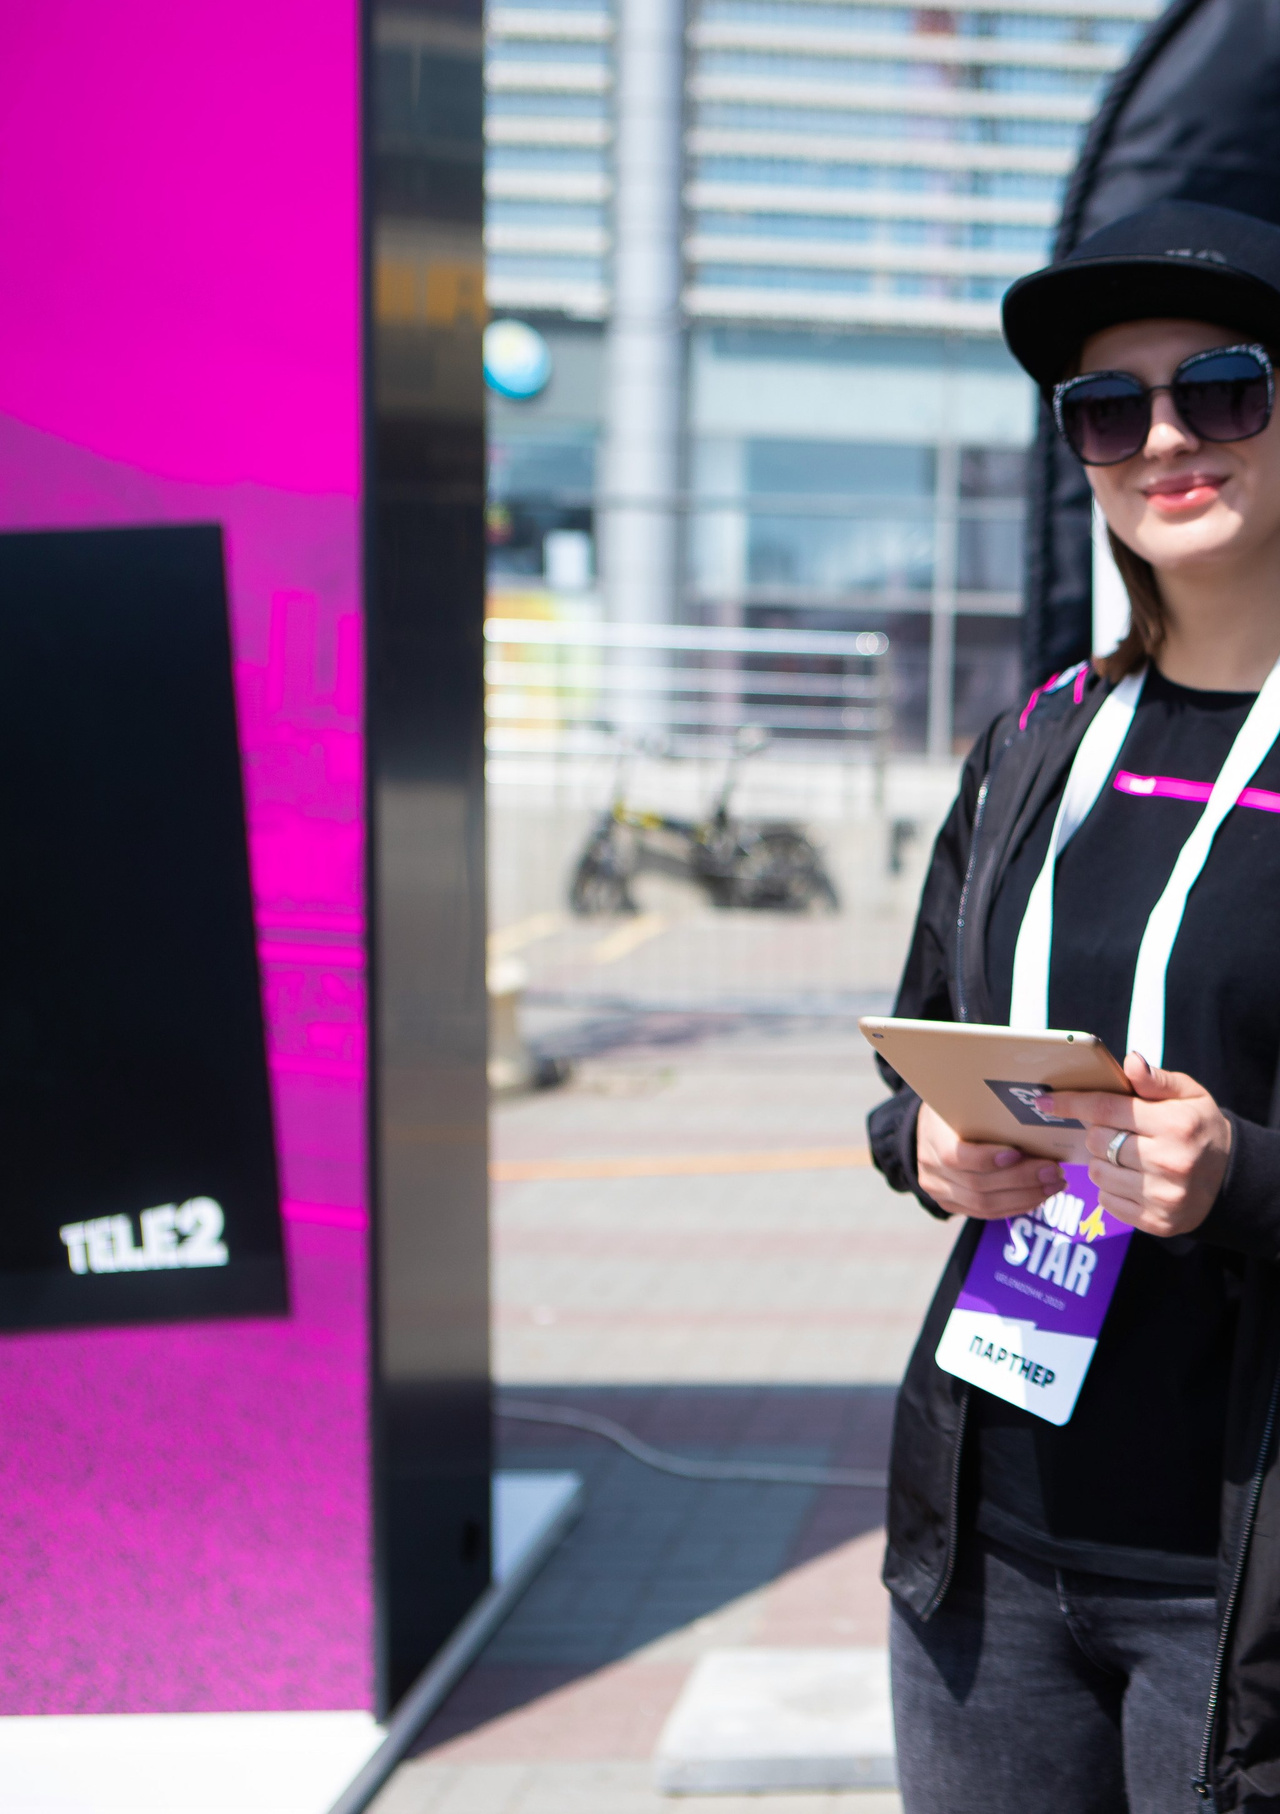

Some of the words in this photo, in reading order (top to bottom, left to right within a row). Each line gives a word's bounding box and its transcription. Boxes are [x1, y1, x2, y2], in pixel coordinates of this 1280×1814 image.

[59, 1195, 229, 1275] TELE2
[1002, 1217, 1098, 1297] STAR
[969, 1335, 1056, 1388] ПАРТНЕР
